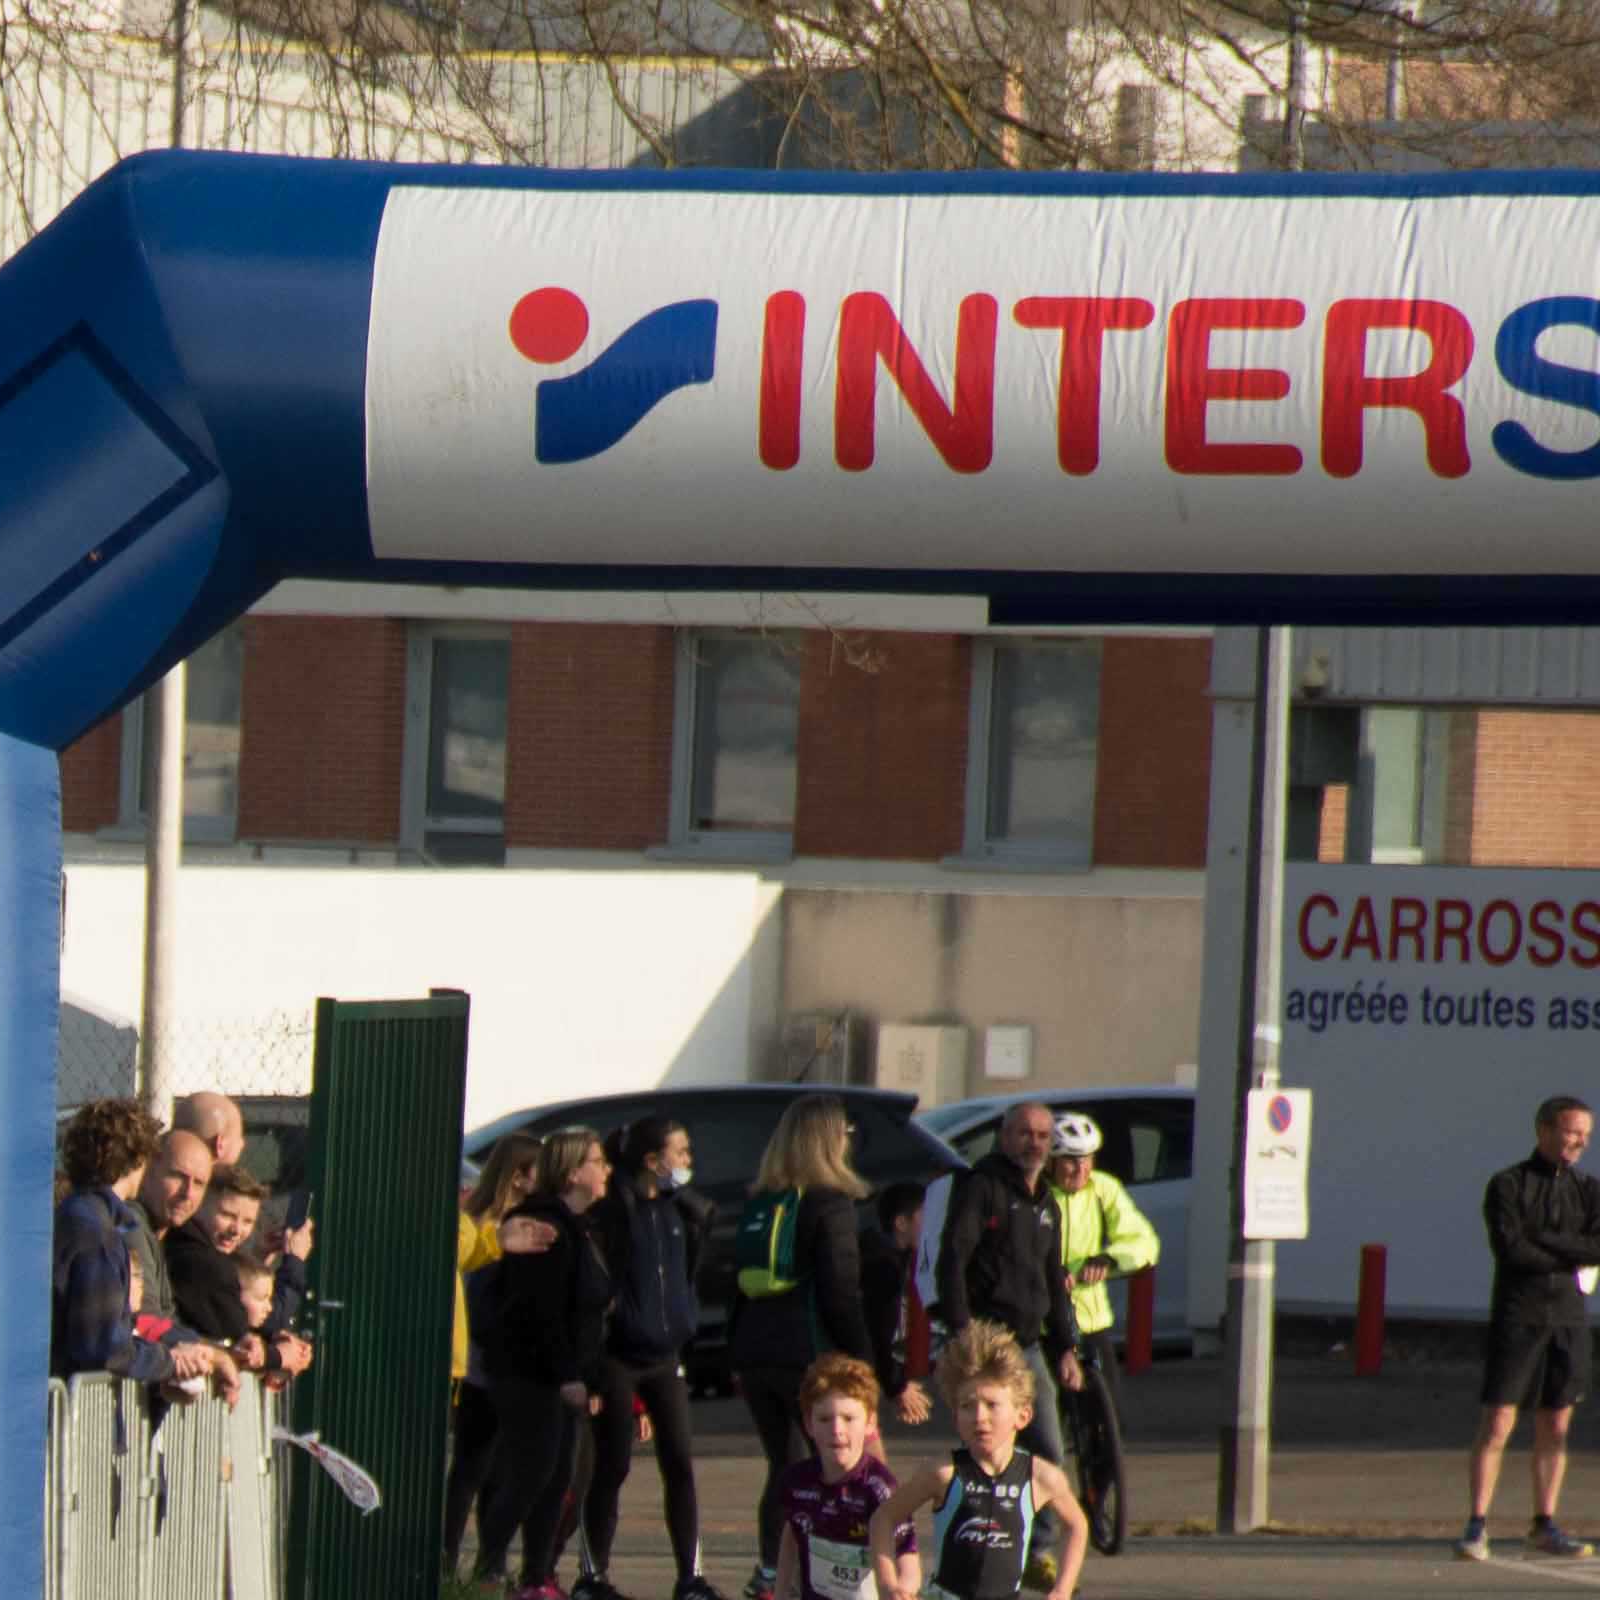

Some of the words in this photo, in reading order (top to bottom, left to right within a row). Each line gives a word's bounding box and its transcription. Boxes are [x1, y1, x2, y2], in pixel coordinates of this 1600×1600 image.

[757, 288, 1600, 479] INTERS
[1298, 893, 1600, 969] CARROSS
[1286, 979, 1409, 1033] agréée
[1421, 986, 1536, 1029] toutes
[831, 1565, 860, 1583] 453
